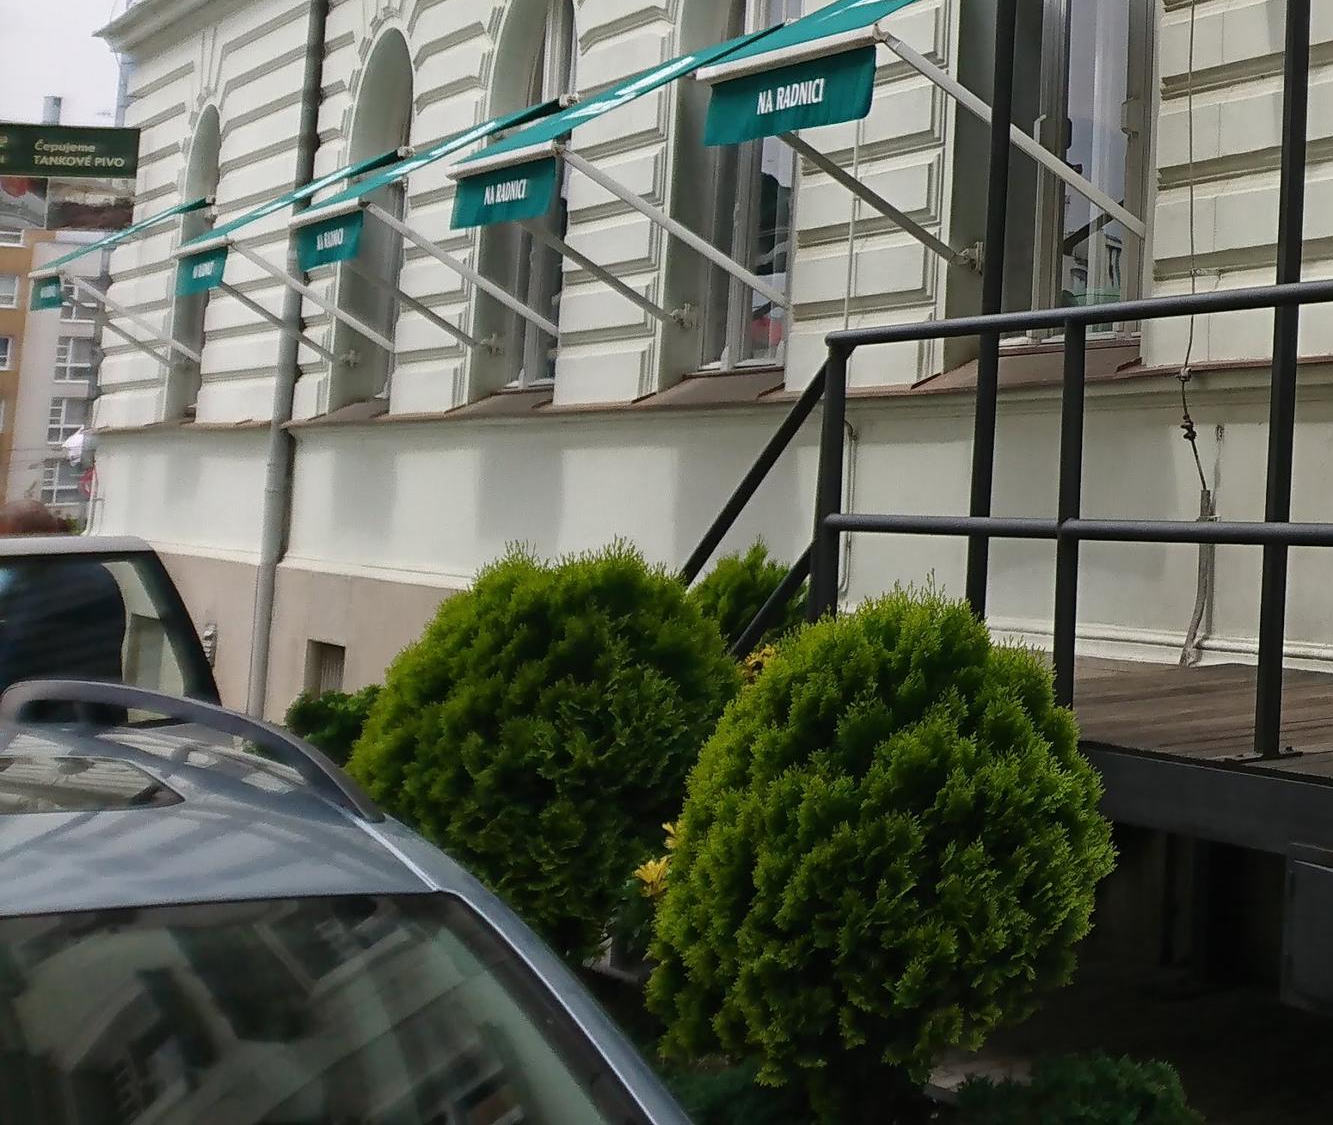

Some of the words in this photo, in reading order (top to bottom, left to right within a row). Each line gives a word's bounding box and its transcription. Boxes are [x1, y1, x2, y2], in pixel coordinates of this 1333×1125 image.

[756, 89, 774, 115] NA
[775, 78, 825, 110] RADNICI
[34, 138, 96, 154] Čepujeme
[33, 154, 92, 167] TANKOVÉ
[94, 156, 125, 168] PIVO
[483, 186, 495, 206] NA
[495, 178, 528, 204] RADNICI
